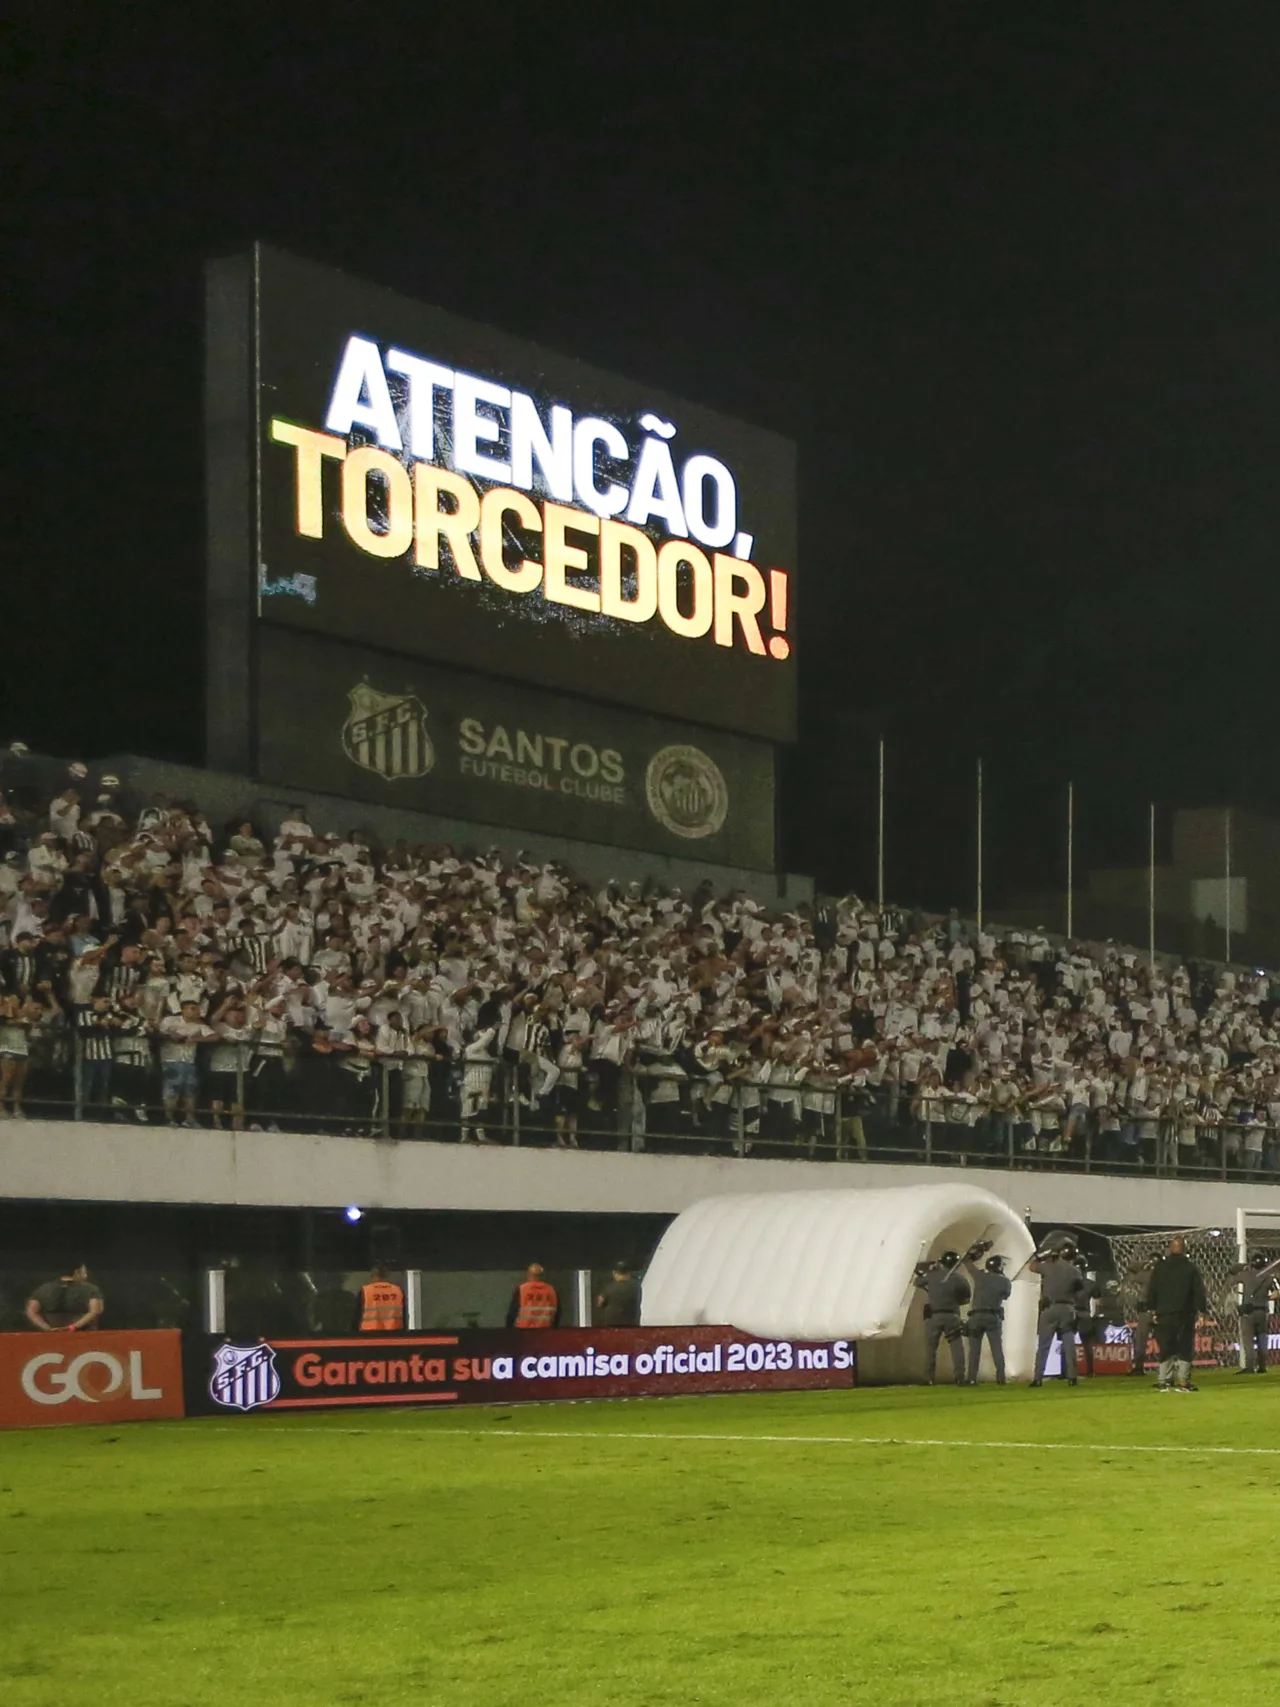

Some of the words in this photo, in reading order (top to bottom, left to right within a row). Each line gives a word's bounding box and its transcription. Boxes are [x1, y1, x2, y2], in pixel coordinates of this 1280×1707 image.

[324, 334, 755, 561] ATENÇÃO,
[271, 418, 792, 661] TORCEDOR!
[459, 718, 625, 784] SANTOS
[459, 758, 553, 791] FUTEBOL
[560, 777, 625, 804] CLUBE
[22, 1350, 163, 1405] GOL
[294, 1353, 446, 1387] Garanta
[452, 1356, 513, 1380] sua
[520, 1346, 629, 1379] camisa
[634, 1343, 722, 1376] oficial
[726, 1341, 794, 1372] 2023
[797, 1348, 829, 1370] na
